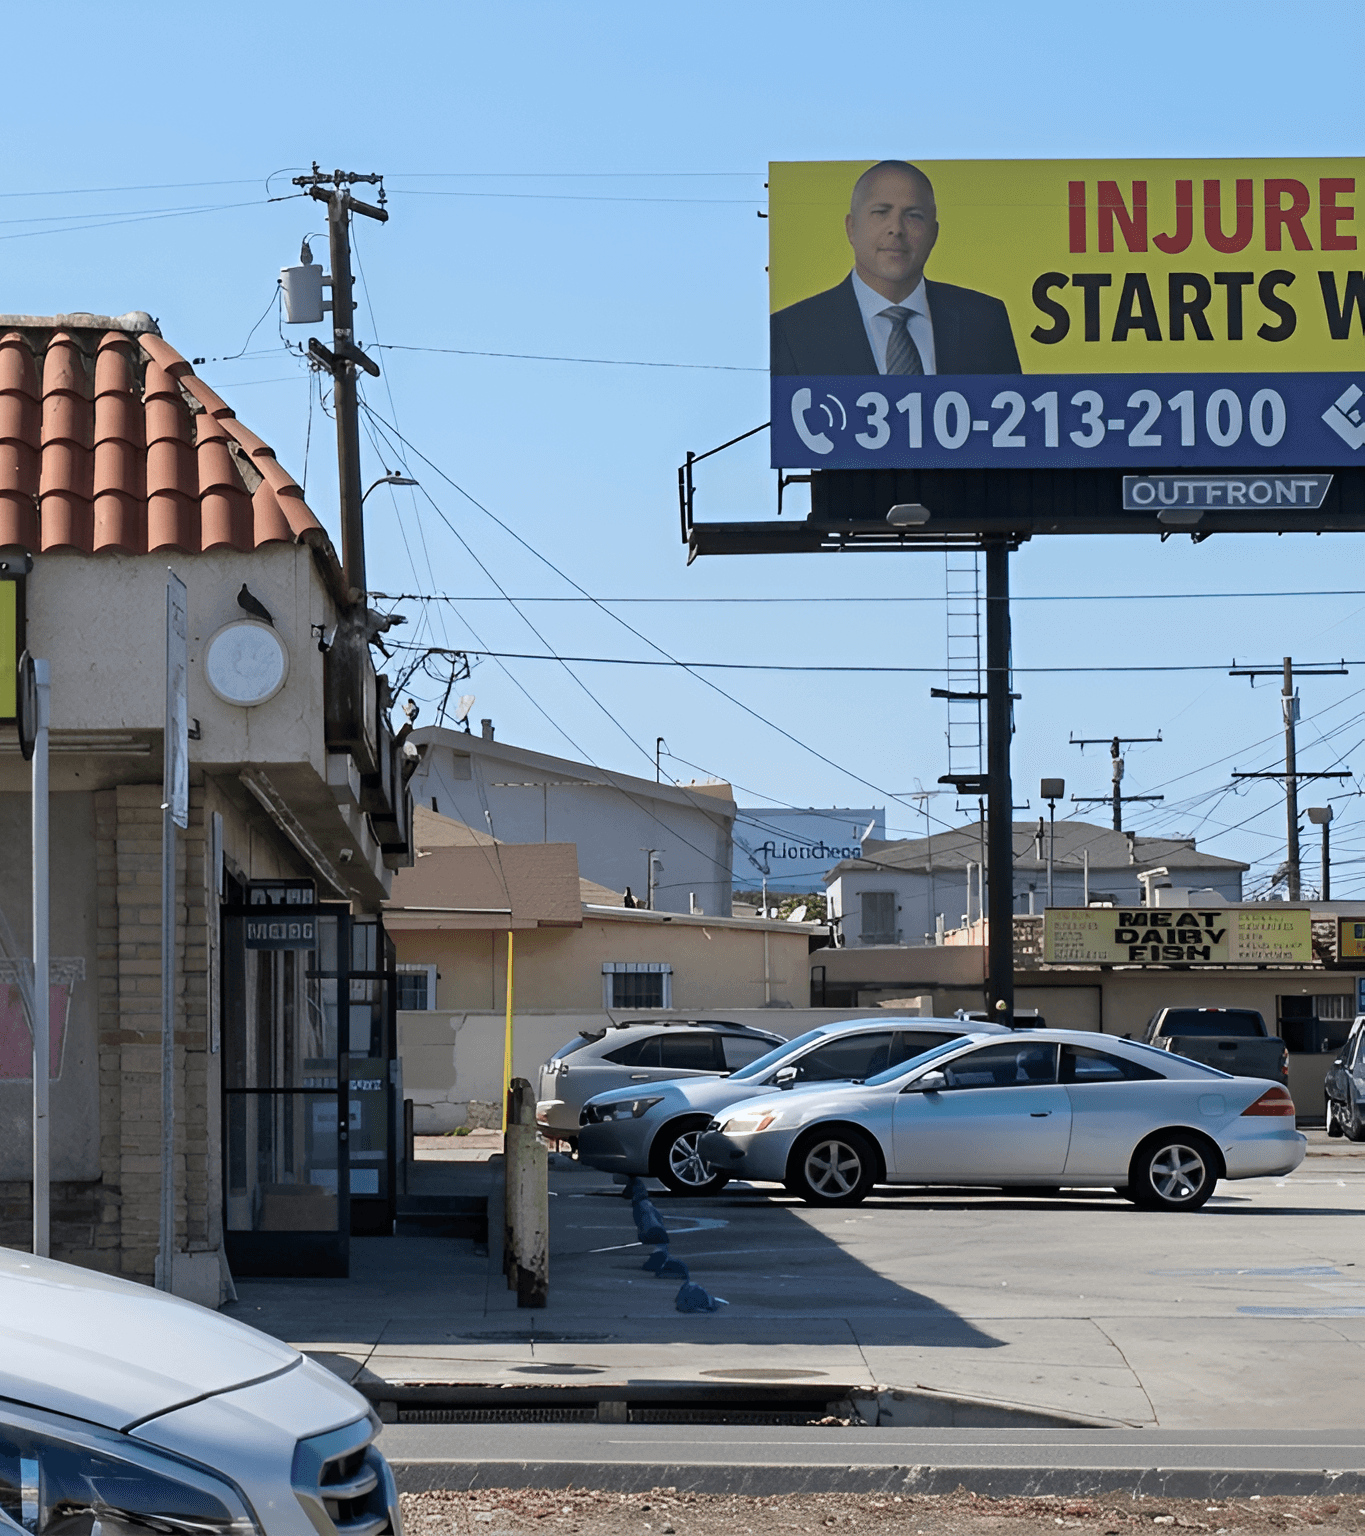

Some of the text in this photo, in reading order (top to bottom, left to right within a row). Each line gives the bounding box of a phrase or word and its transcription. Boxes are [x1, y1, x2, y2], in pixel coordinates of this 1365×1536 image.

[1068, 178, 1358, 254] INJURE
[1030, 269, 1297, 344] STARTS
[854, 387, 1287, 450] 310-213-2100
[1132, 480, 1318, 505] OUTFRONT
[1118, 912, 1222, 928] MEAT
[1114, 928, 1227, 945] DAIRY
[1128, 945, 1212, 961] FISH
